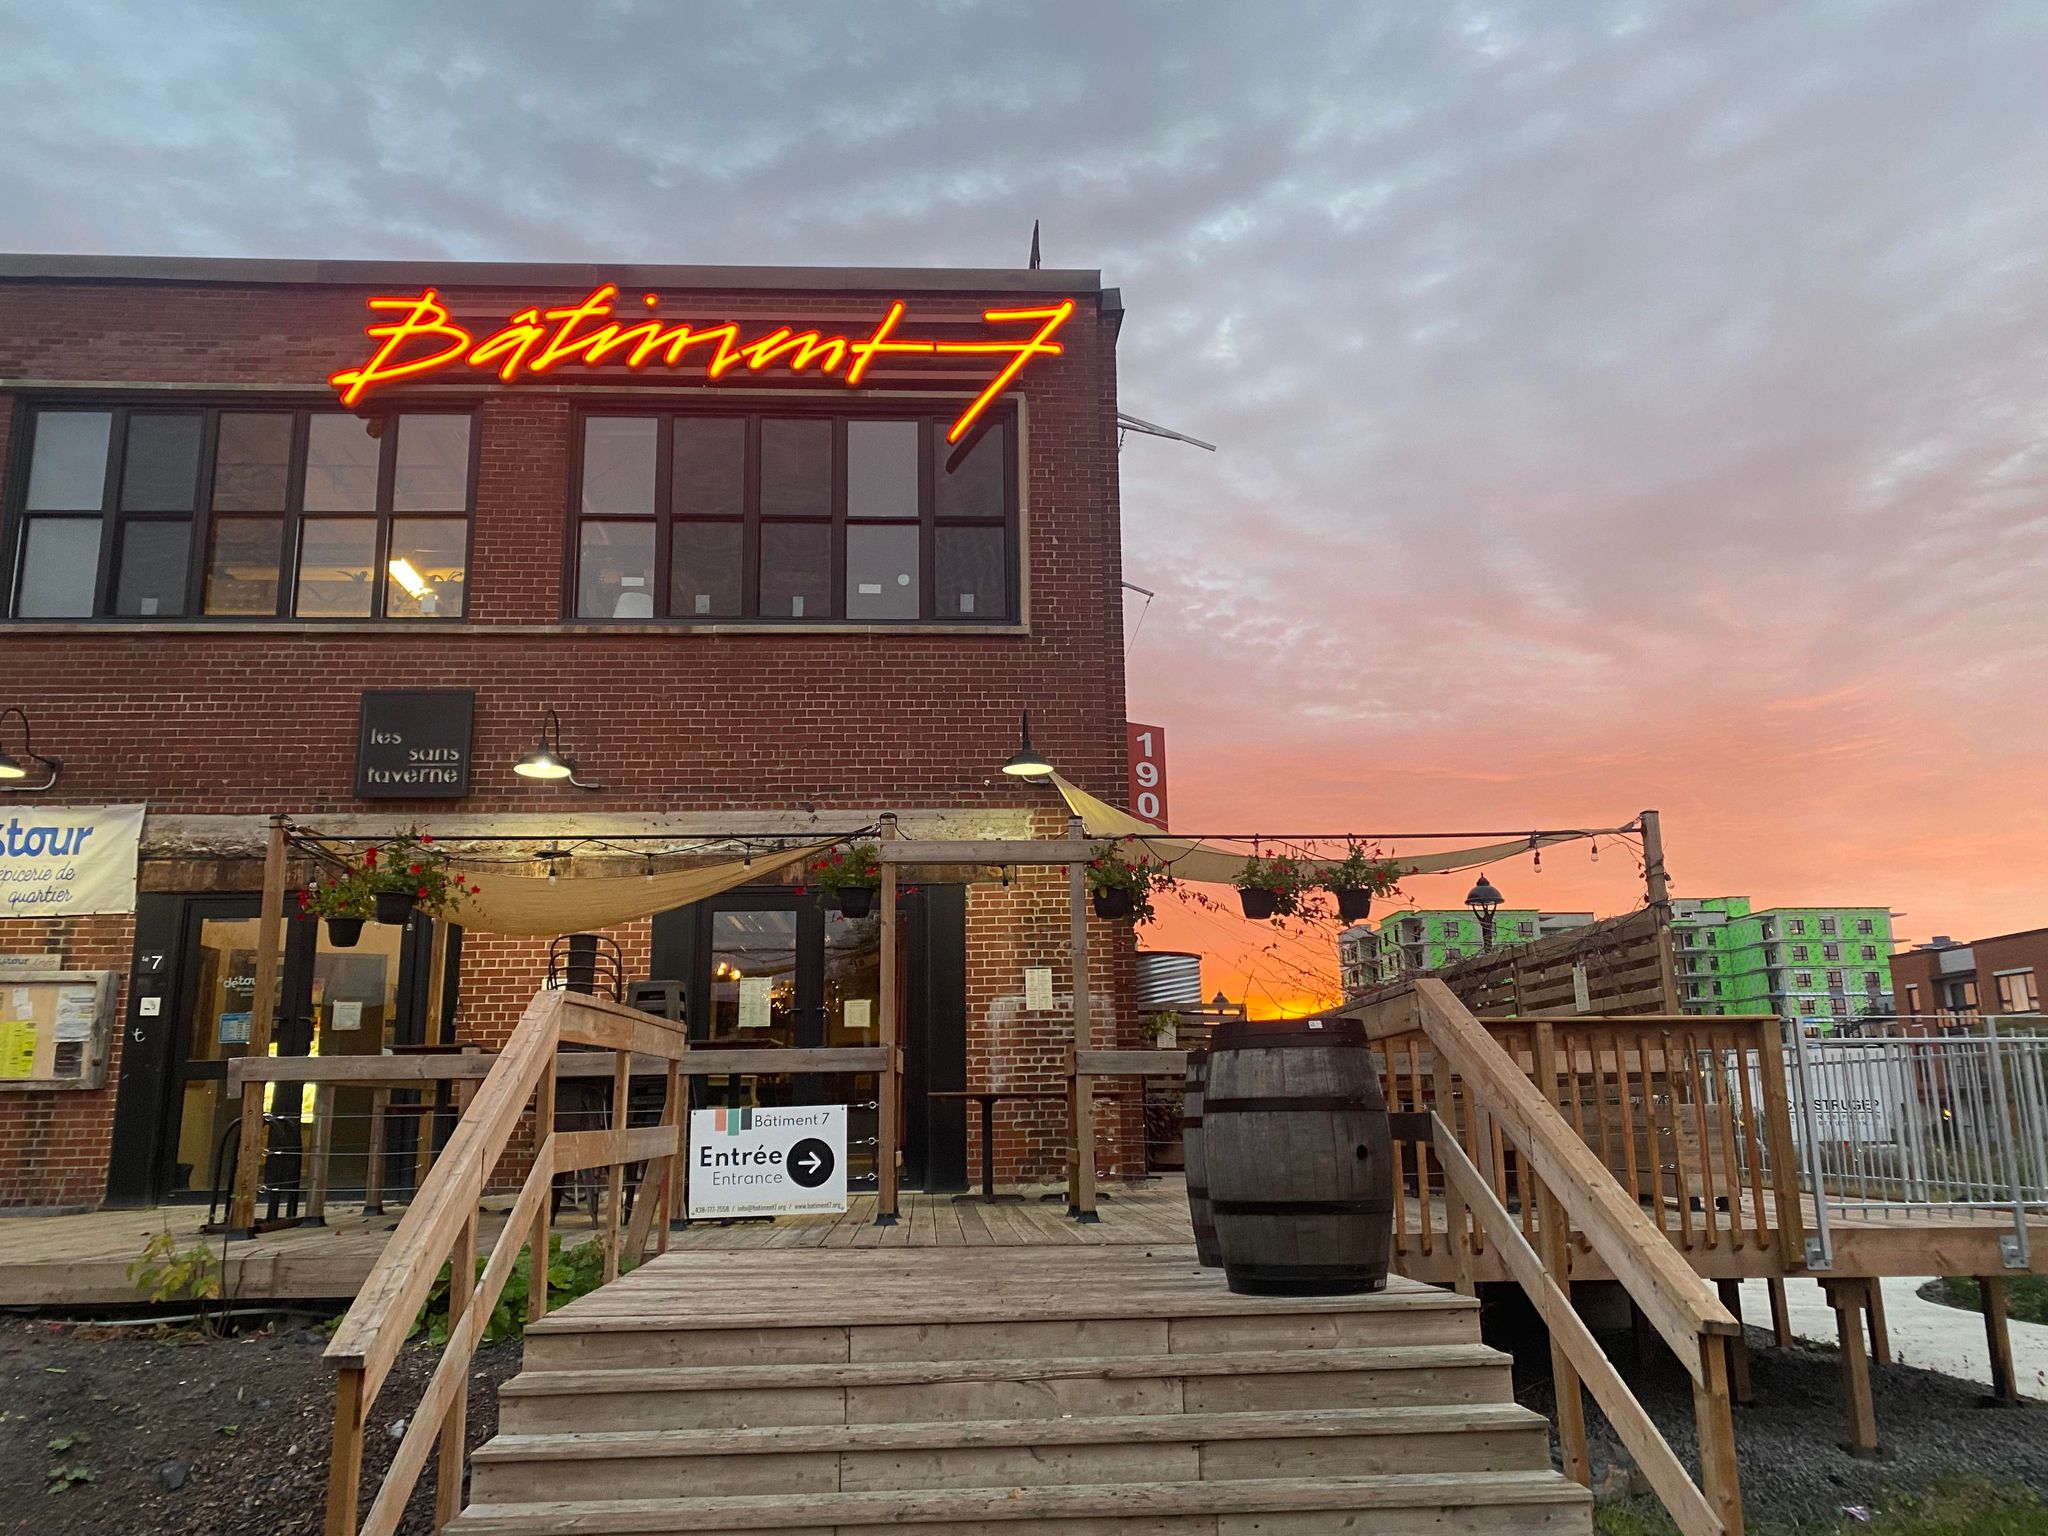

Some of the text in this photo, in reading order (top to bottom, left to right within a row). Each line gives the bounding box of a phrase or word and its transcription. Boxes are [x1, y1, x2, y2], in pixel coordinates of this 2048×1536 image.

[331, 283, 1076, 444] Bâtiment 7
[370, 728, 402, 745] les
[408, 748, 460, 761] sans
[367, 767, 458, 783] taverne
[1135, 732, 1160, 819] 190
[0, 818, 94, 857] tour
[55, 861, 76, 881] de
[8, 885, 73, 910] quartier
[151, 955, 163, 970] 7
[755, 1112, 830, 1128] Bâtiment 7
[700, 1144, 783, 1167] Entrée
[713, 1172, 783, 1186] Entrance
